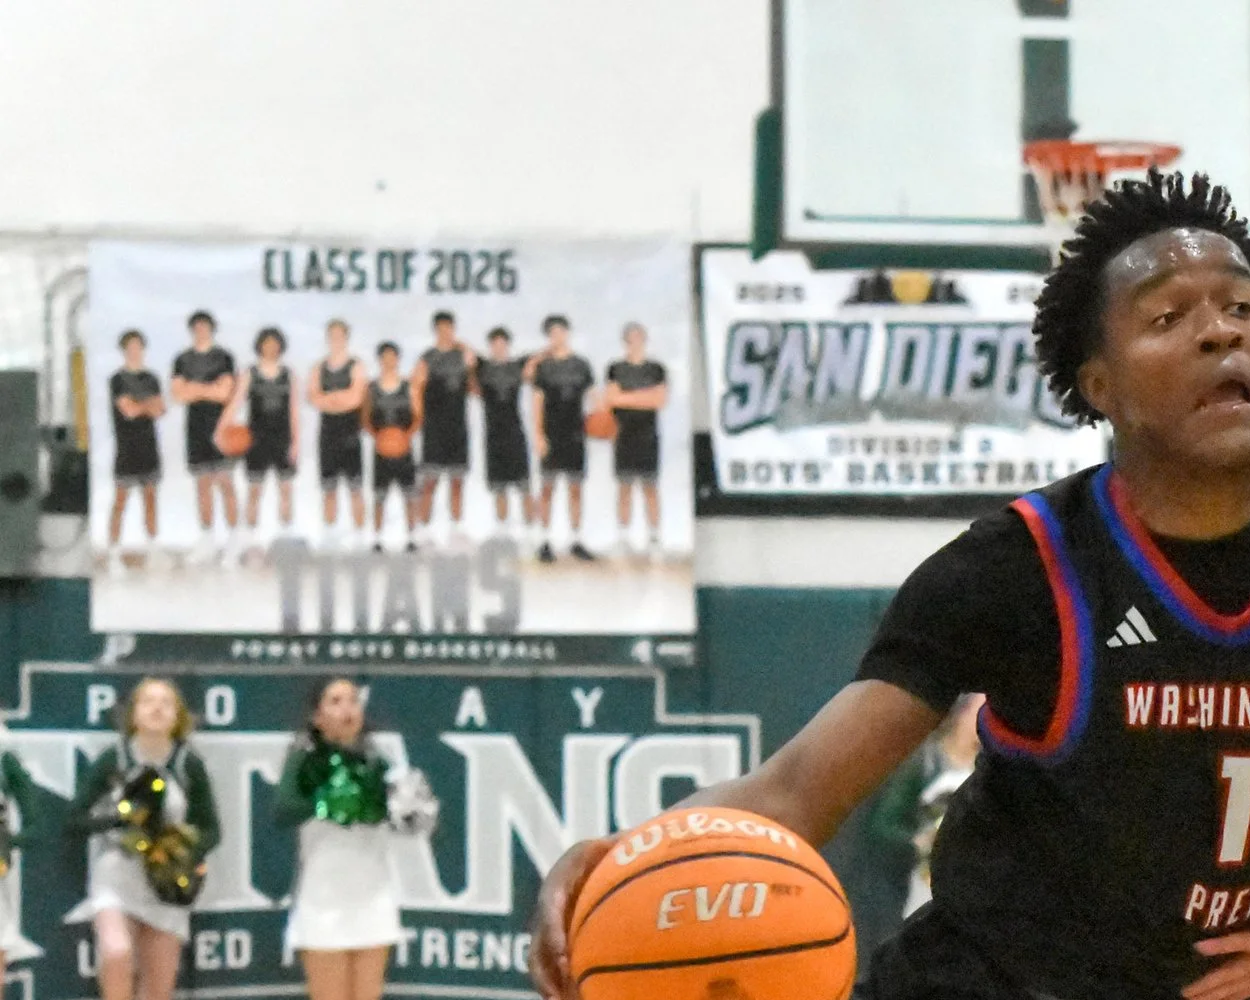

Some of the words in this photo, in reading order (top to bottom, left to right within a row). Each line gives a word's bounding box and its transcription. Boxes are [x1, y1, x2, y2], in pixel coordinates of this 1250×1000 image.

[264, 248, 367, 293] CLASS
[375, 248, 415, 293] OF
[427, 249, 519, 293] 2026
[721, 321, 874, 434] SAN
[828, 437, 963, 455] DIVISION
[267, 536, 522, 634] TITANS
[231, 640, 318, 660] POWAY
[329, 640, 394, 660] BOYS
[404, 640, 556, 661] BASKETBALL
[86, 684, 604, 728] POAY
[614, 812, 797, 866] Wilson
[656, 882, 768, 930] EVO
